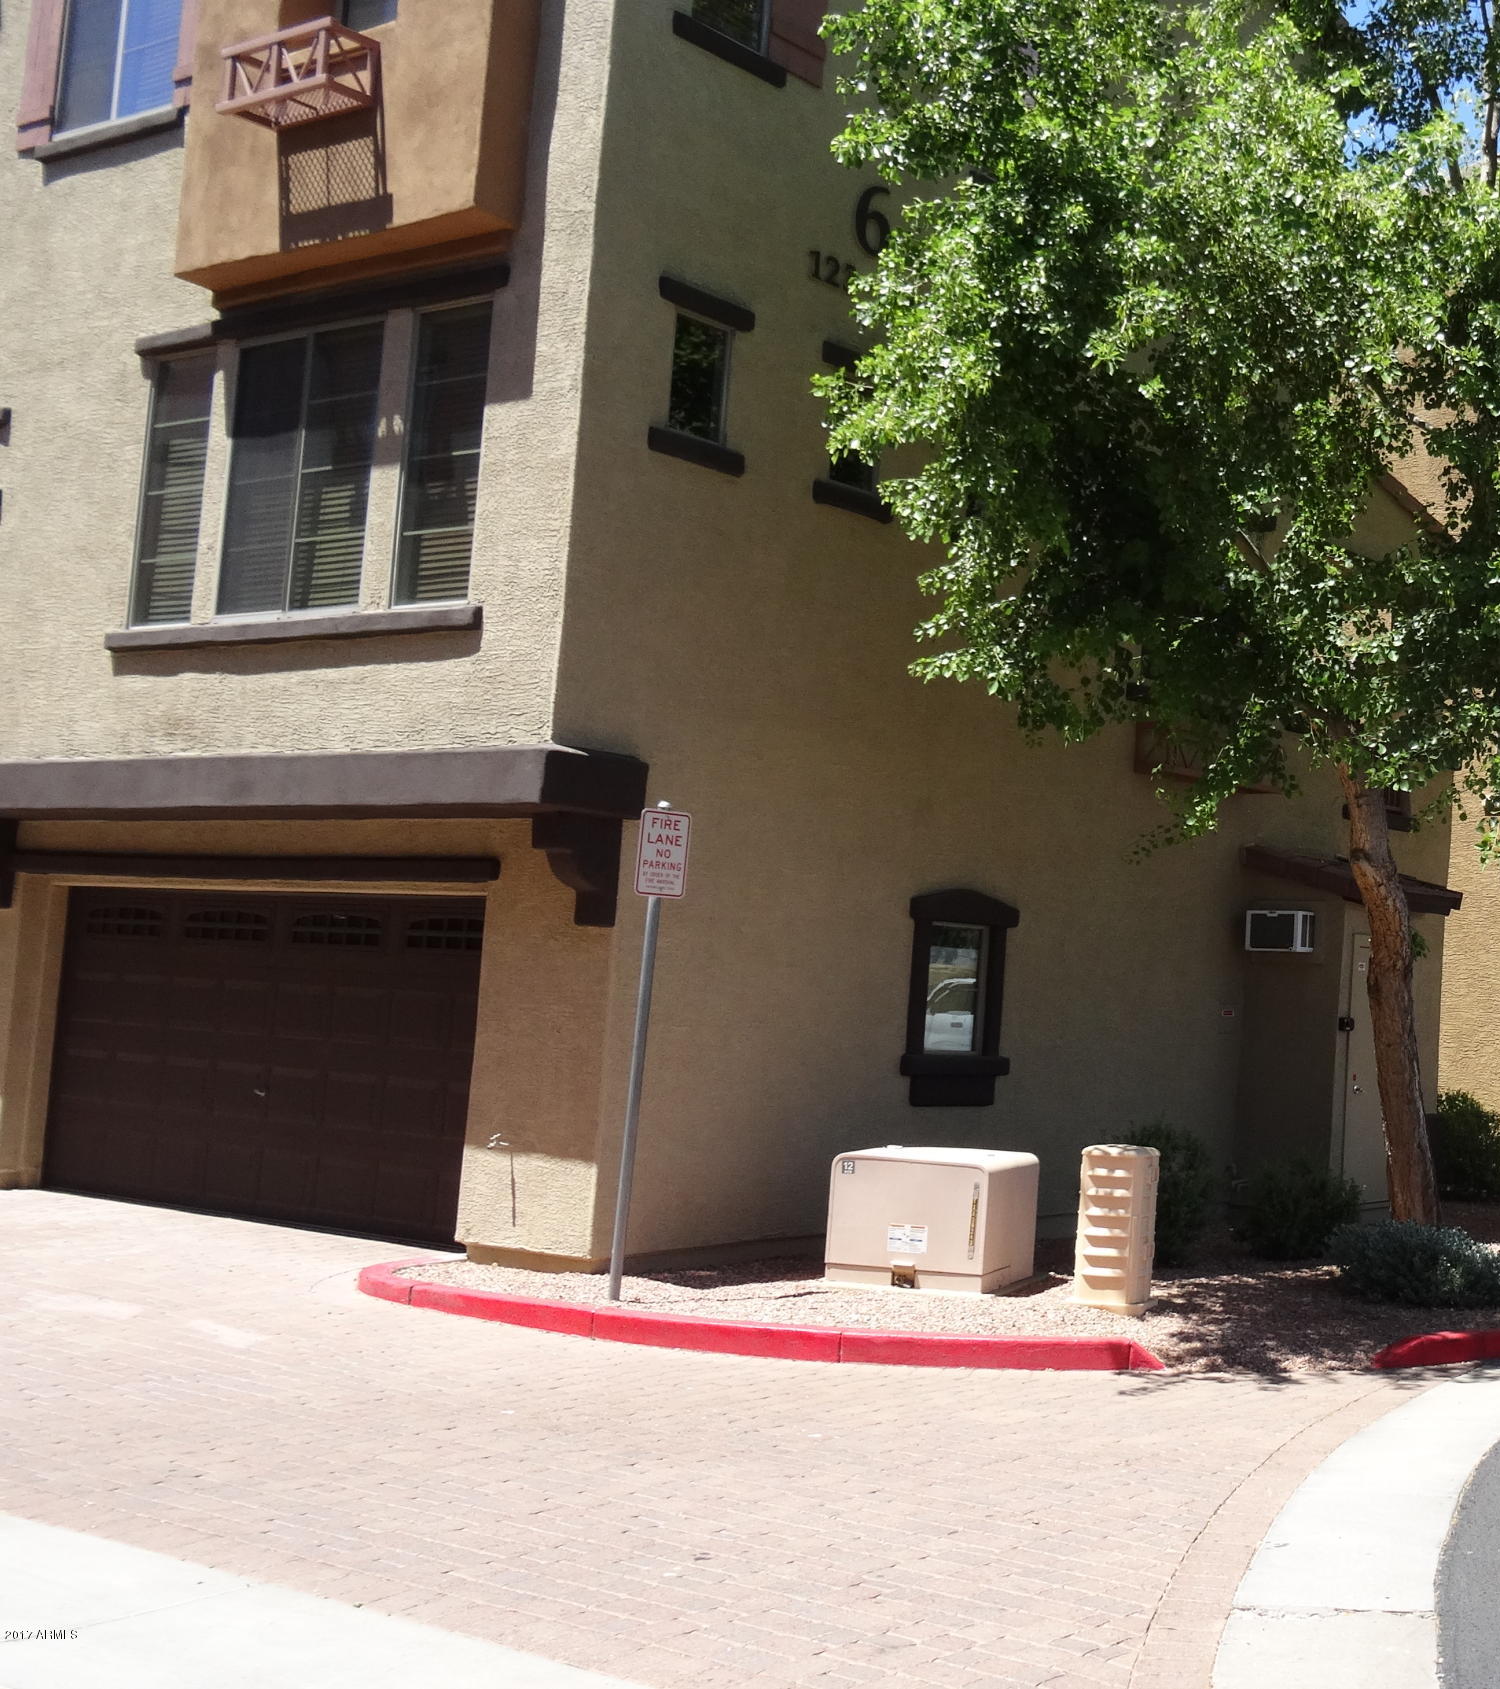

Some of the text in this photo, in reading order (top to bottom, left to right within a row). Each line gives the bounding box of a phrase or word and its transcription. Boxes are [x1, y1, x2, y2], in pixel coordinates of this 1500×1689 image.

[855, 186, 891, 258] 6
[651, 817, 681, 831] FIRE
[647, 832, 682, 847] LANE
[656, 849, 671, 859] NO
[642, 860, 682, 872] PARKING
[843, 1161, 853, 1170] 12
